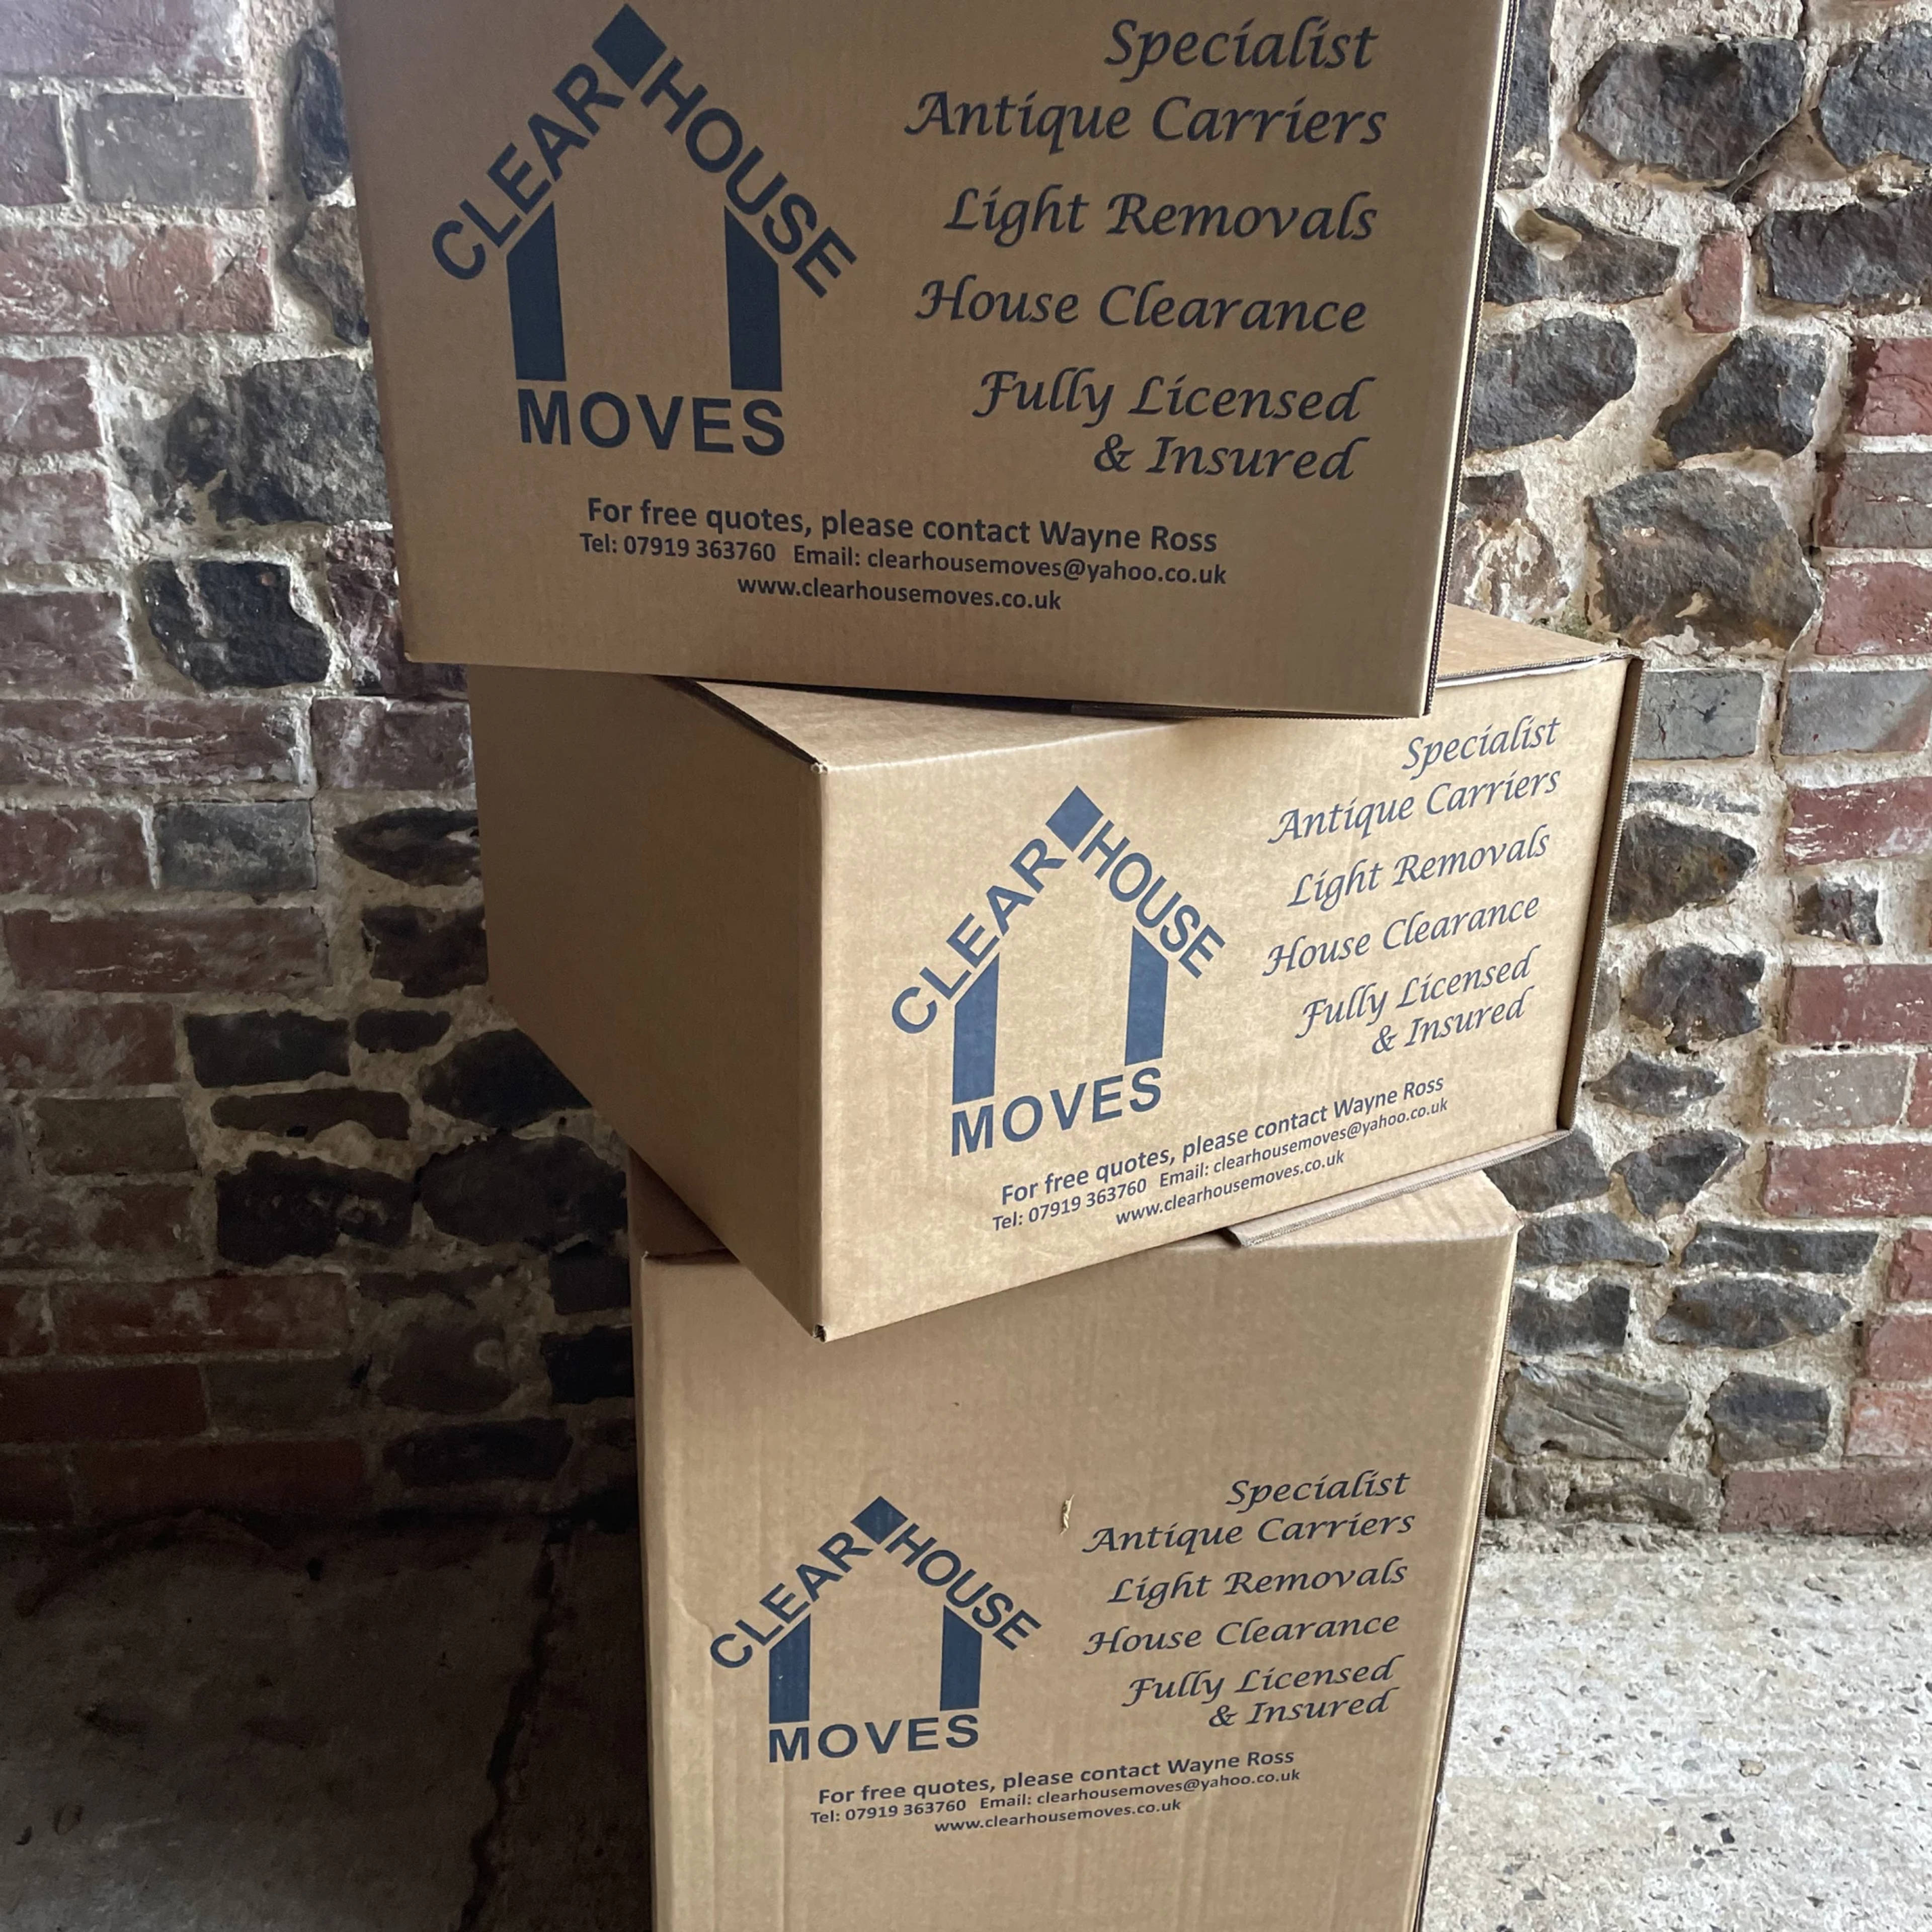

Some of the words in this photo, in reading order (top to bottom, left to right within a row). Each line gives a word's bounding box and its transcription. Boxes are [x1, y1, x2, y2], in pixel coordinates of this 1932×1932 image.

[1104, 16, 1379, 83] Specialist
[904, 90, 1131, 155] Antique
[1153, 96, 1387, 144] Carriers
[432, 63, 625, 280] CLEAR
[640, 56, 857, 298] HOUSE
[943, 184, 1089, 248] Light
[1106, 191, 1377, 240] Removals
[915, 274, 1078, 324] House
[1100, 280, 1366, 333] Clearance
[518, 388, 784, 456] MOVES
[972, 367, 1114, 428] Fully
[1128, 374, 1376, 422] Licensed
[1094, 434, 1135, 472] &
[1145, 437, 1370, 480] Insured
[588, 498, 632, 523] For
[640, 499, 697, 527] free
[706, 509, 811, 537] quotes,
[822, 509, 913, 540] please
[923, 519, 1030, 544] contact
[1039, 521, 1140, 553] Wayne
[1151, 526, 1217, 552] Ross
[580, 533, 617, 553] Tel:
[624, 535, 689, 557] 07919
[696, 539, 775, 561] 363760
[794, 545, 860, 566] Email:
[868, 548, 1226, 584] clearhousemoves@yahoo.co.uk
[737, 577, 1061, 610] www.clearhousemoves.co.uk
[1402, 715, 1561, 780] Specialist
[1267, 796, 1414, 844] Antique
[1427, 770, 1561, 815] Carriers
[1078, 820, 1226, 979] HOUSE
[1287, 859, 1384, 911] Light
[1392, 824, 1550, 886] Removals
[892, 839, 1067, 1033] CLEAR
[1262, 934, 1371, 976] House
[1383, 897, 1539, 949] Clearance
[1295, 983, 1388, 1038] Fully
[1396, 944, 1541, 1009] Licensed
[1372, 1025, 1398, 1054] &
[1404, 985, 1535, 1047] Insured
[952, 1067, 1161, 1157] MOVES
[1002, 1182, 1038, 1205] For
[1044, 1170, 1089, 1194] free
[1096, 1150, 1175, 1183] quotes,
[1183, 1129, 1248, 1163] please
[1255, 1106, 1328, 1139] contact
[1334, 1090, 1397, 1118] Wayne
[1403, 1078, 1443, 1100] Ross
[993, 1212, 1023, 1231] Tel:
[1029, 1196, 1081, 1222] 07919
[1086, 1178, 1146, 1207] 363760
[1160, 1162, 1209, 1187] Email:
[1214, 1097, 1447, 1173] clearhousemoves@yahoo.co.uk
[1116, 1150, 1344, 1225] www.clearhousemoves.co.uk
[1226, 1470, 1410, 1514] Specialist
[1082, 1522, 1243, 1556] Antique
[1258, 1512, 1415, 1542] Carriers
[710, 1532, 873, 1668] CLEAR
[884, 1523, 1041, 1650] HOUSE
[1107, 1571, 1212, 1609] Light
[1223, 1557, 1407, 1595] Removals
[1083, 1626, 1201, 1655] House
[1217, 1616, 1399, 1645] Clearance
[1121, 1670, 1225, 1707] Fully
[1234, 1655, 1405, 1693] Licensed
[1209, 1705, 1238, 1727] &
[1245, 1687, 1400, 1725] Insured
[769, 1714, 978, 1762] MOVES
[811, 1810, 840, 1823] Tel:
[845, 1805, 898, 1820] 07919
[904, 1799, 966, 1815] 363760
[981, 1794, 1031, 1809] Email:
[1037, 1769, 1300, 1804] clearhousemoves@yahoo.co.uk
[819, 1789, 855, 1804] For
[861, 1785, 906, 1801] free
[914, 1779, 995, 1799] quotes,
[1003, 1772, 1073, 1792] please
[1081, 1762, 1160, 1782] contact
[1168, 1757, 1240, 1775] Wayne
[1247, 1752, 1294, 1766] Ross
[935, 1799, 1181, 1832] www.clearhousemoves.co.uk
